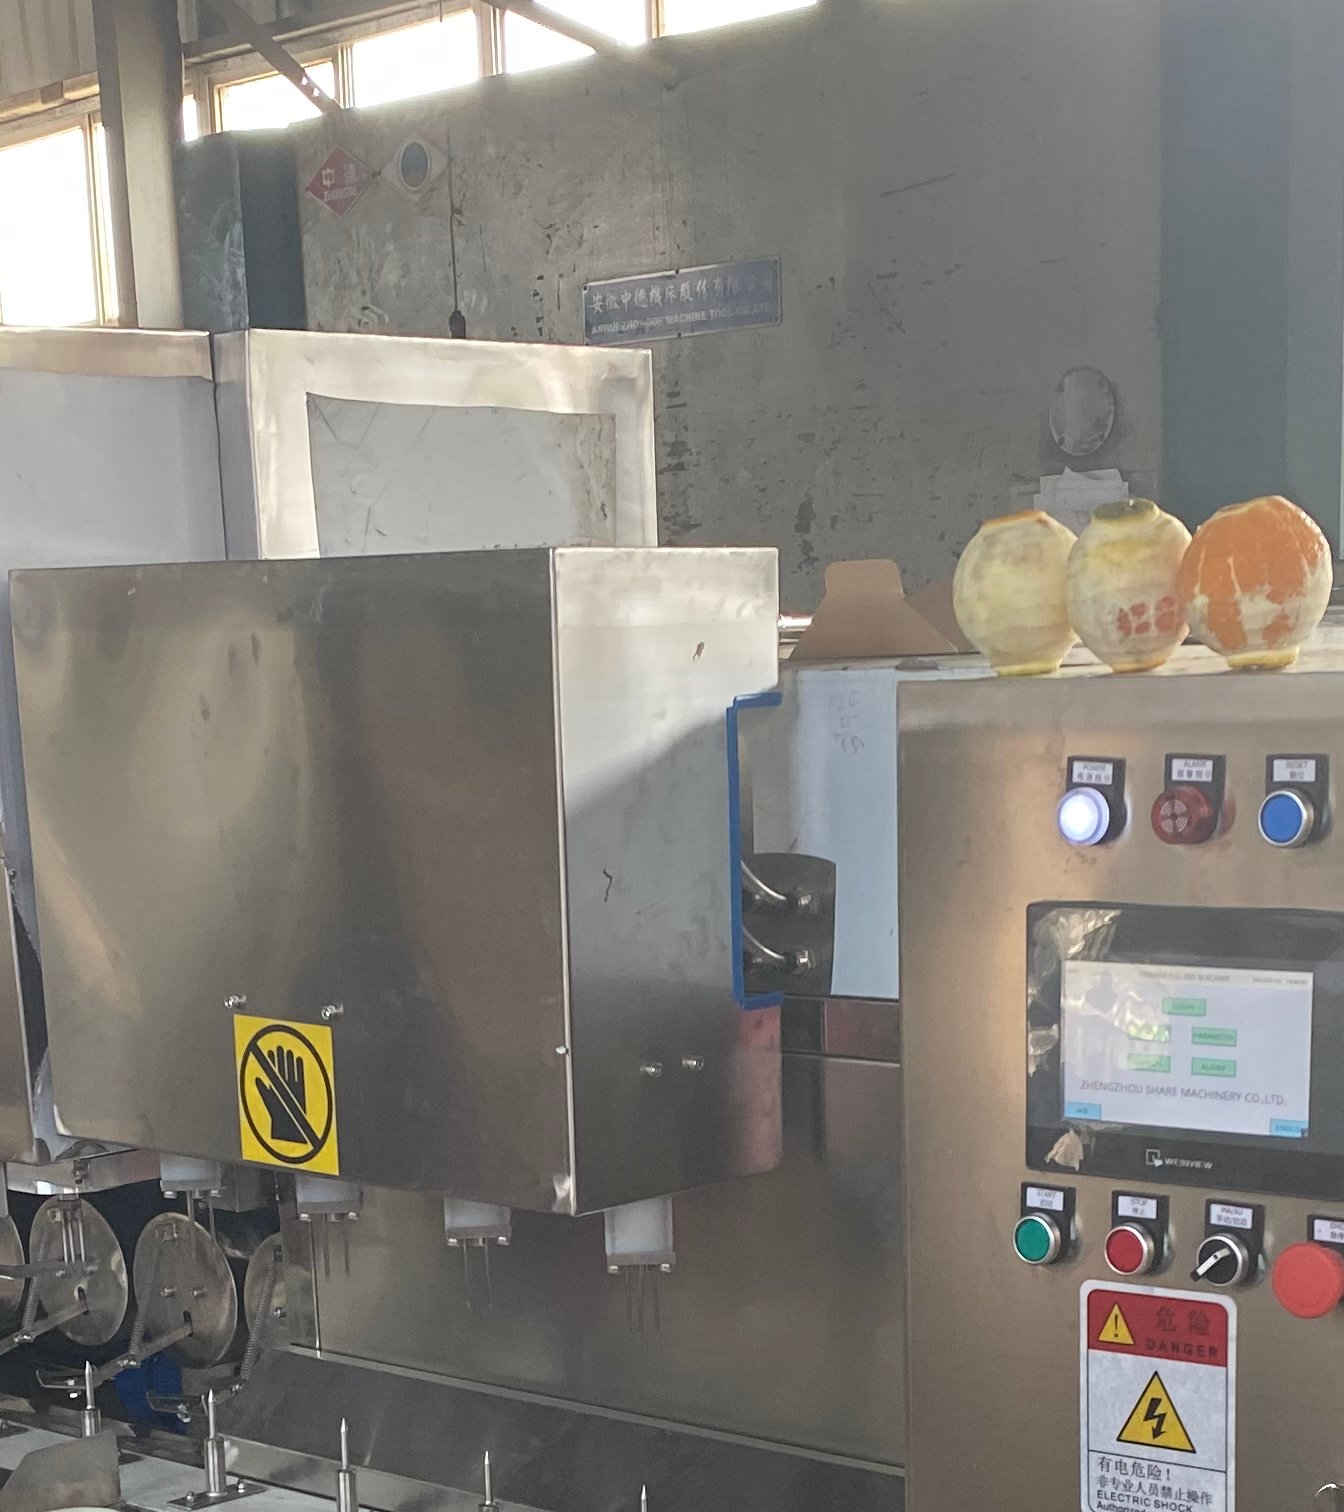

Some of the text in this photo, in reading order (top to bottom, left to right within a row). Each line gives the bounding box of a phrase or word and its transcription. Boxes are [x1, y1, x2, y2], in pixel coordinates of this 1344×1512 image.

[591, 322, 619, 335] ANHUI
[664, 310, 707, 325] MACHINE
[1184, 760, 1206, 768] ALARM
[1286, 760, 1308, 769] RESET
[1080, 1079, 1143, 1095] ZHENGZHOU
[1145, 1084, 1178, 1097] SHARE
[1180, 1087, 1241, 1103] MACHINERY
[1155, 1305, 1211, 1337] 危险
[1145, 1338, 1218, 1358] DANGER
[1097, 1475, 1214, 1506] 非专业人员禁止操作
[1097, 1489, 1151, 1507] ELECTRIC
